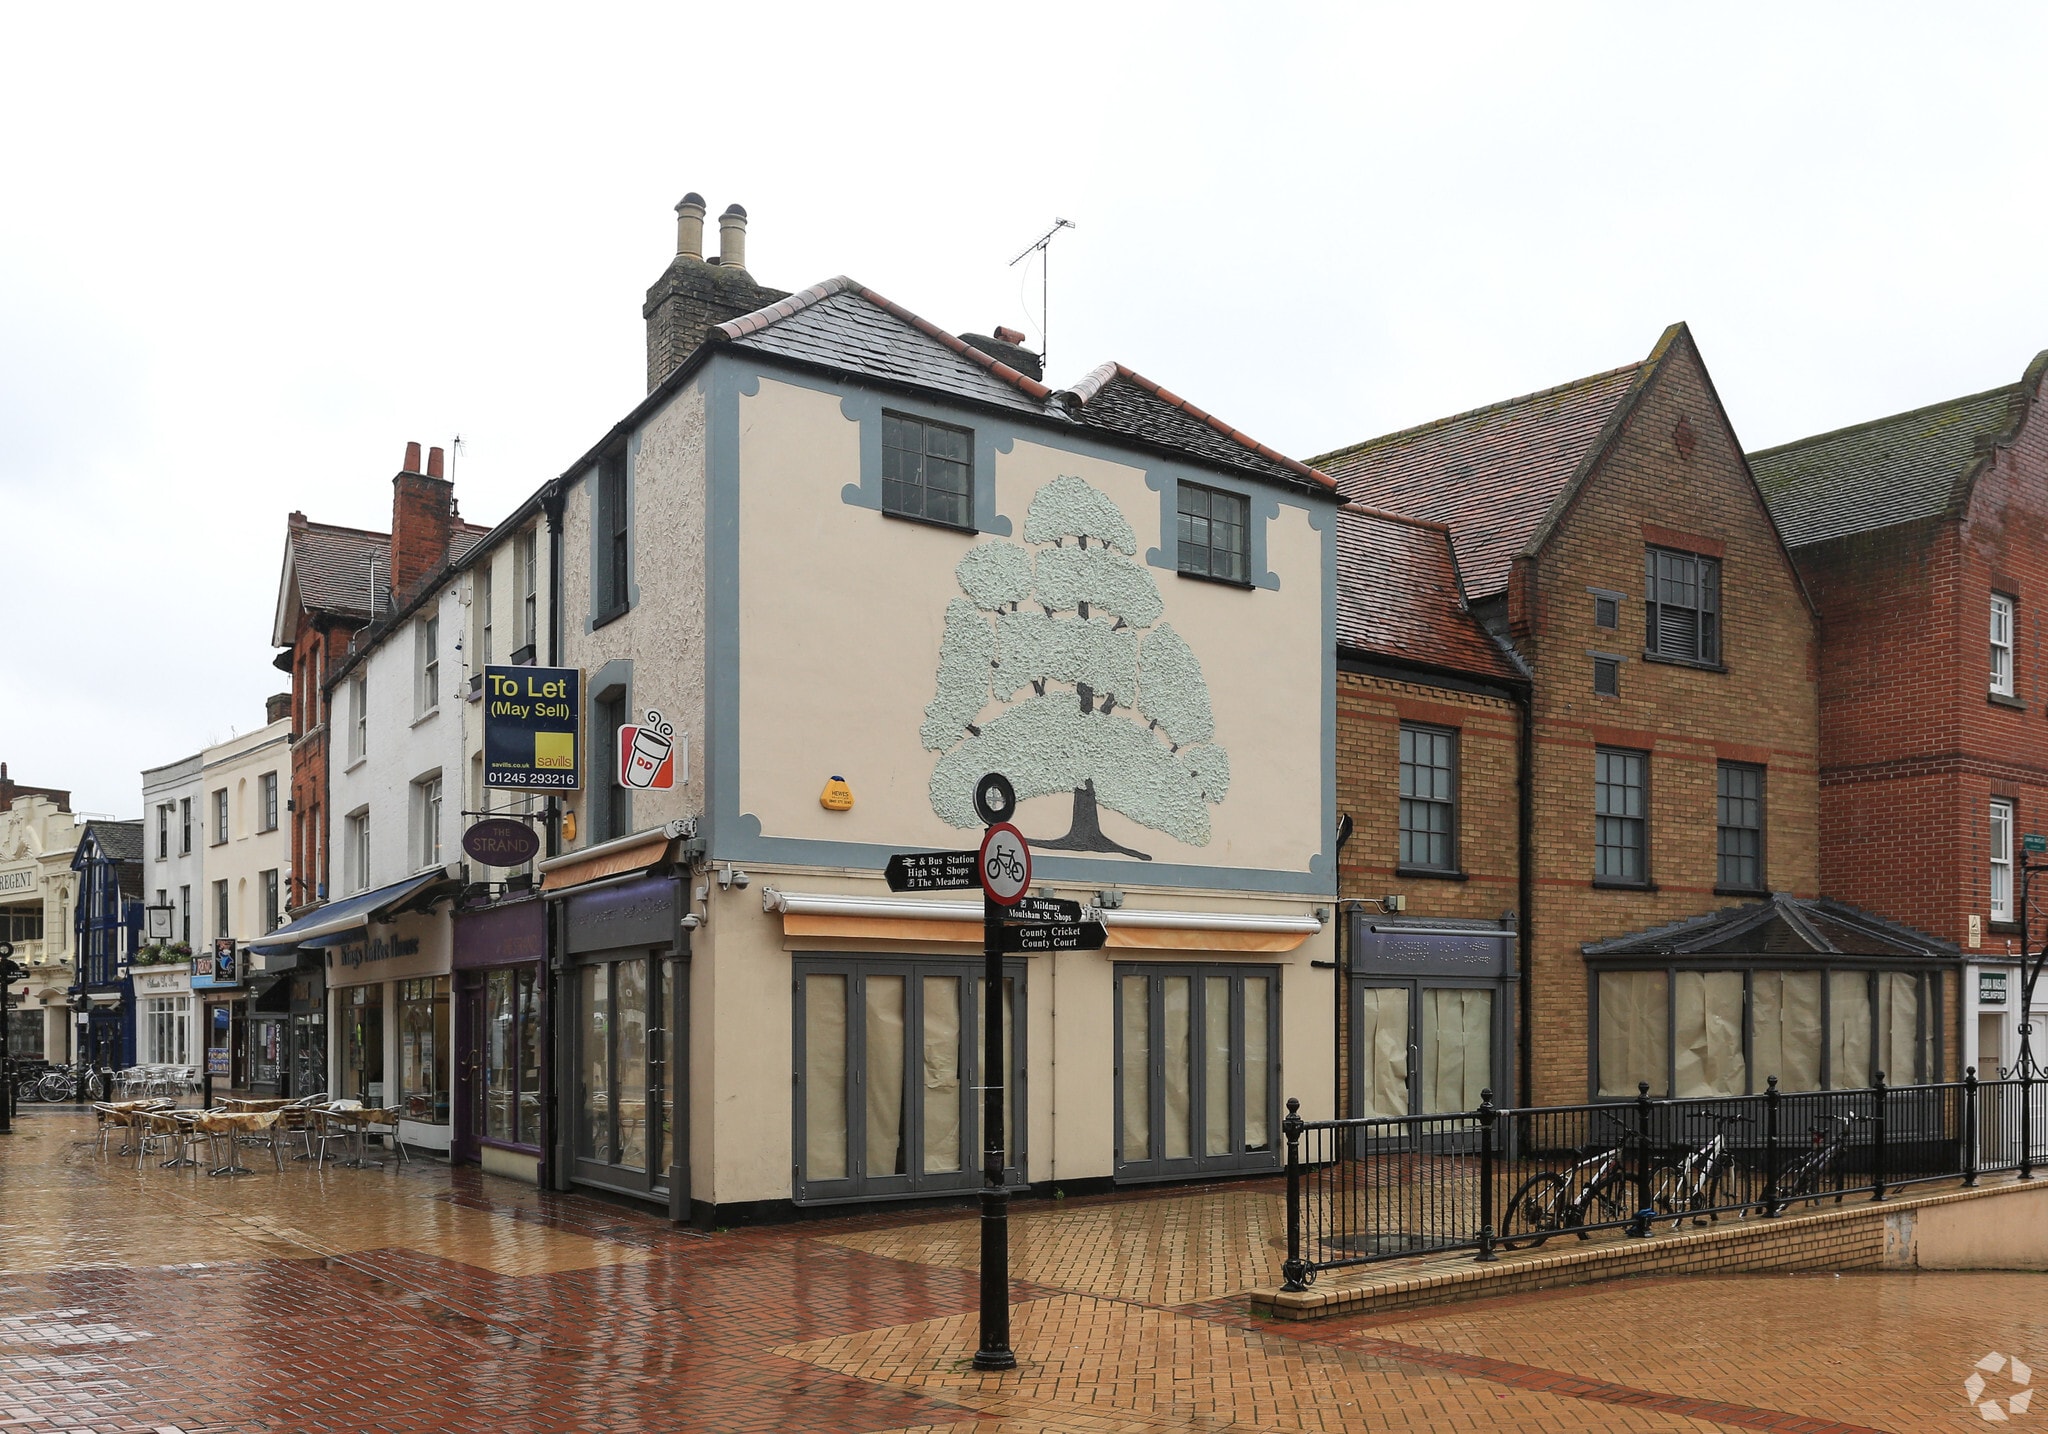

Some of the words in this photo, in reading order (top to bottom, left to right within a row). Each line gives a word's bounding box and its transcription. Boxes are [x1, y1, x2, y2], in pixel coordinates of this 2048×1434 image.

[489, 675, 518, 696] To
[528, 676, 566, 698] Let
[491, 701, 530, 718] (May
[535, 702, 570, 720] Sell)
[537, 756, 572, 768] savills
[637, 757, 653, 770] DD
[489, 772, 526, 784] 01245
[530, 774, 574, 784] 293216
[493, 828, 510, 837] THE
[473, 838, 529, 852] STRAND
[919, 857, 926, 866] &
[928, 857, 942, 865] Bus
[947, 854, 974, 864] Station
[908, 868, 927, 878] High
[931, 868, 942, 876] St.
[946, 866, 968, 876] Shops
[0, 871, 32, 890] REGENT
[918, 878, 932, 886] The
[936, 876, 969, 886] Meadows
[1033, 900, 1060, 912] Mildmay
[1008, 908, 1040, 919] Moulsham
[1043, 912, 1052, 920] St.
[1054, 912, 1072, 922] Shops
[1020, 928, 1046, 938] County
[1052, 927, 1080, 936] Cricket
[1022, 939, 1050, 948] County
[1054, 938, 1077, 946] Court
